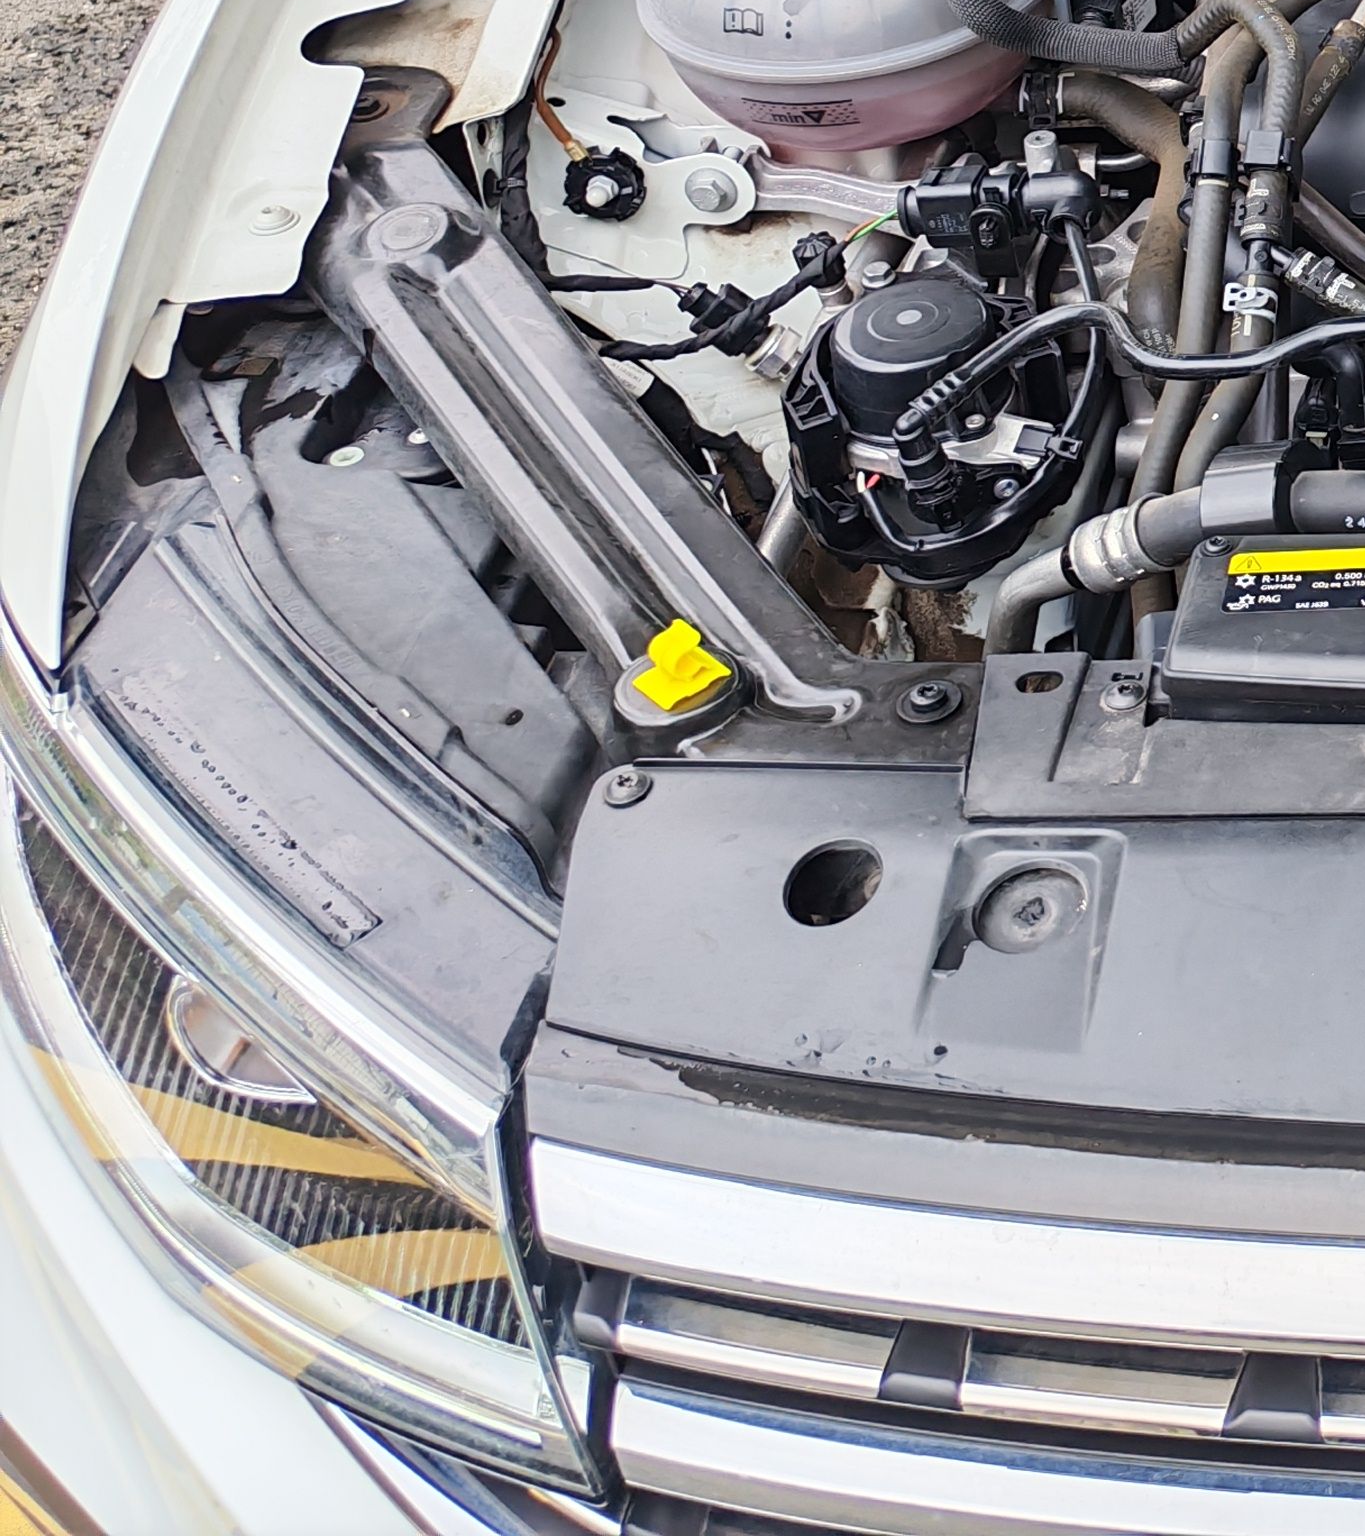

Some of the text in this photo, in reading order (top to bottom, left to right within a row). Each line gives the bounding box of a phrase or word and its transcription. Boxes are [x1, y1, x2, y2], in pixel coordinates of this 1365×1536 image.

[771, 112, 806, 124] min
[1335, 572, 1363, 581] 0.500
[1257, 594, 1281, 604] PAG
